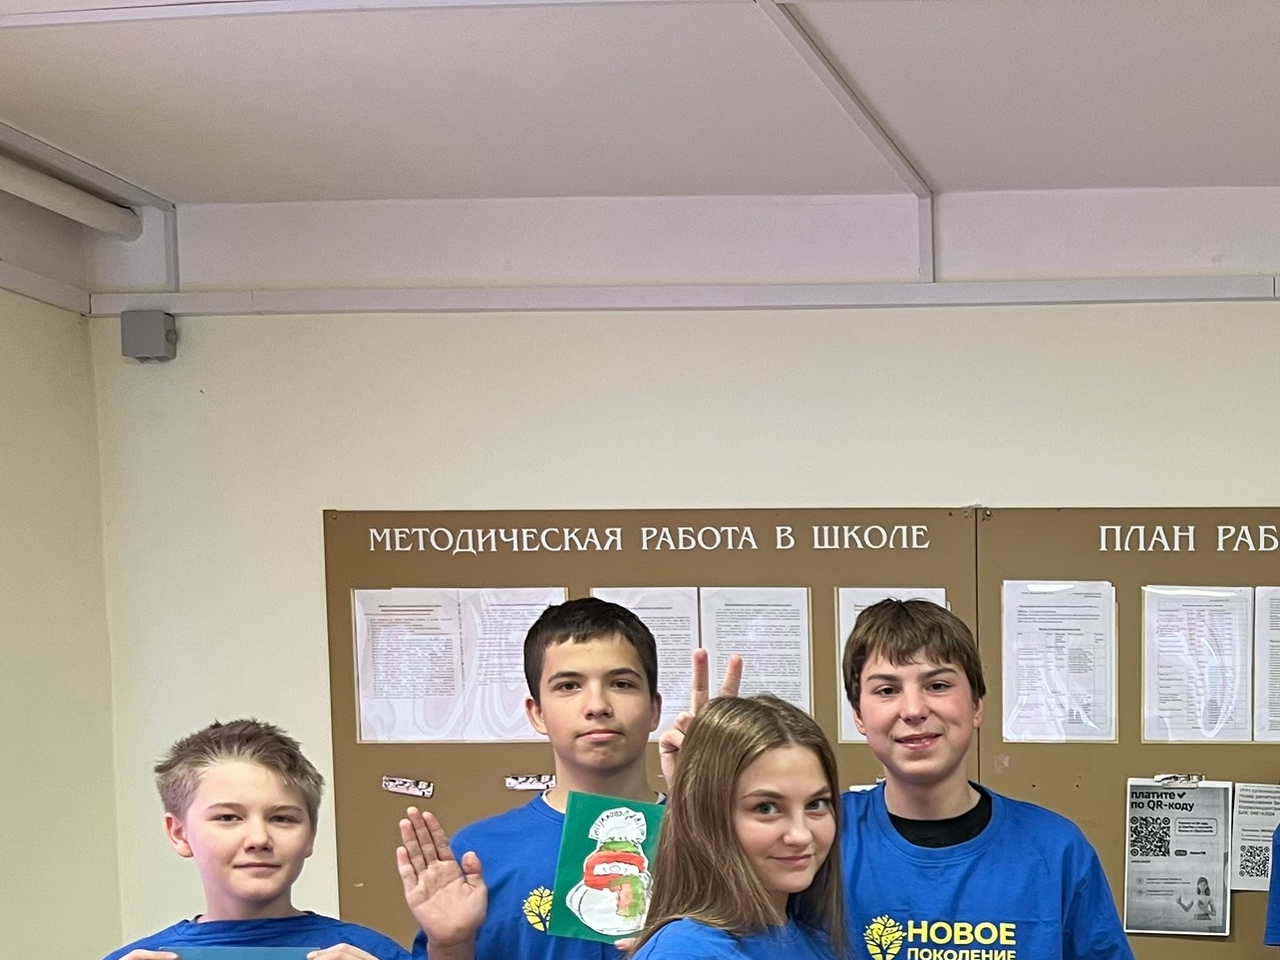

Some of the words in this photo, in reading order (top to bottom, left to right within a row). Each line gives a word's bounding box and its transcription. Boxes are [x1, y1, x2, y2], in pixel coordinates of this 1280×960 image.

[369, 527, 623, 556] МЕТОДИЧЕСКАЯ
[641, 526, 758, 550] РАБОТА
[775, 526, 796, 549] В
[812, 525, 931, 549] ШКОЛЕ
[1099, 524, 1196, 552] ПЛАН
[1131, 791, 1176, 800] платите
[1131, 801, 1145, 809] по
[1147, 800, 1195, 812] QR-коду
[907, 919, 1016, 945] НОВОЕ
